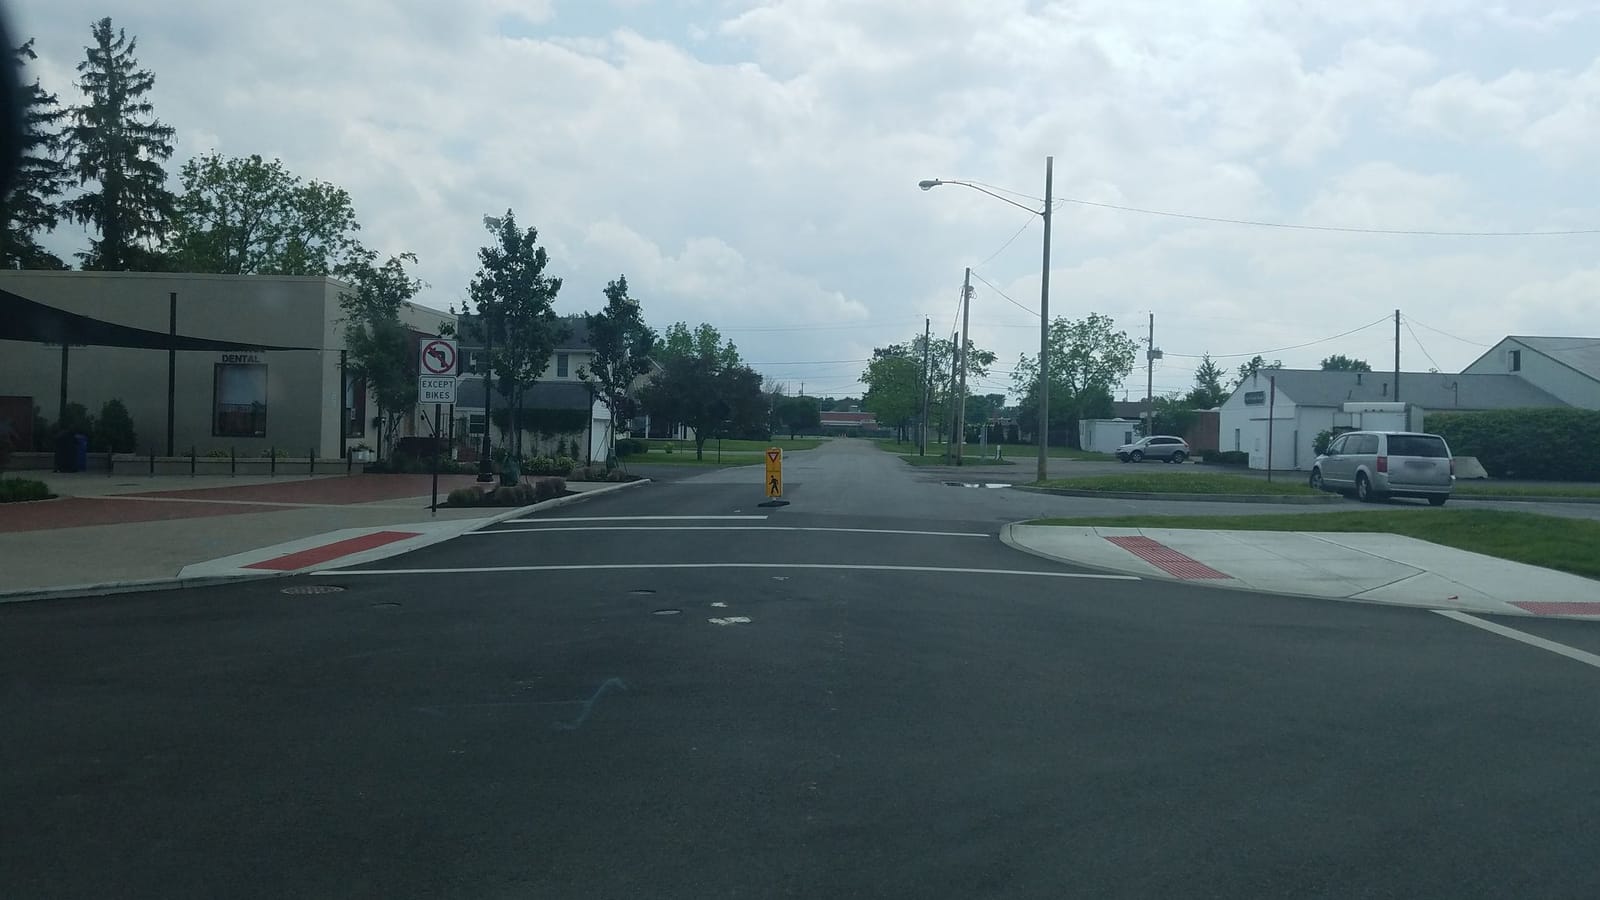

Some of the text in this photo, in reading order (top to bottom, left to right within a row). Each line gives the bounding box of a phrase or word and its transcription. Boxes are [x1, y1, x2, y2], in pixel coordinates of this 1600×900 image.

[222, 354, 261, 363] DENTAL
[422, 380, 453, 388] EXCEPT
[425, 391, 450, 399] BIKES
